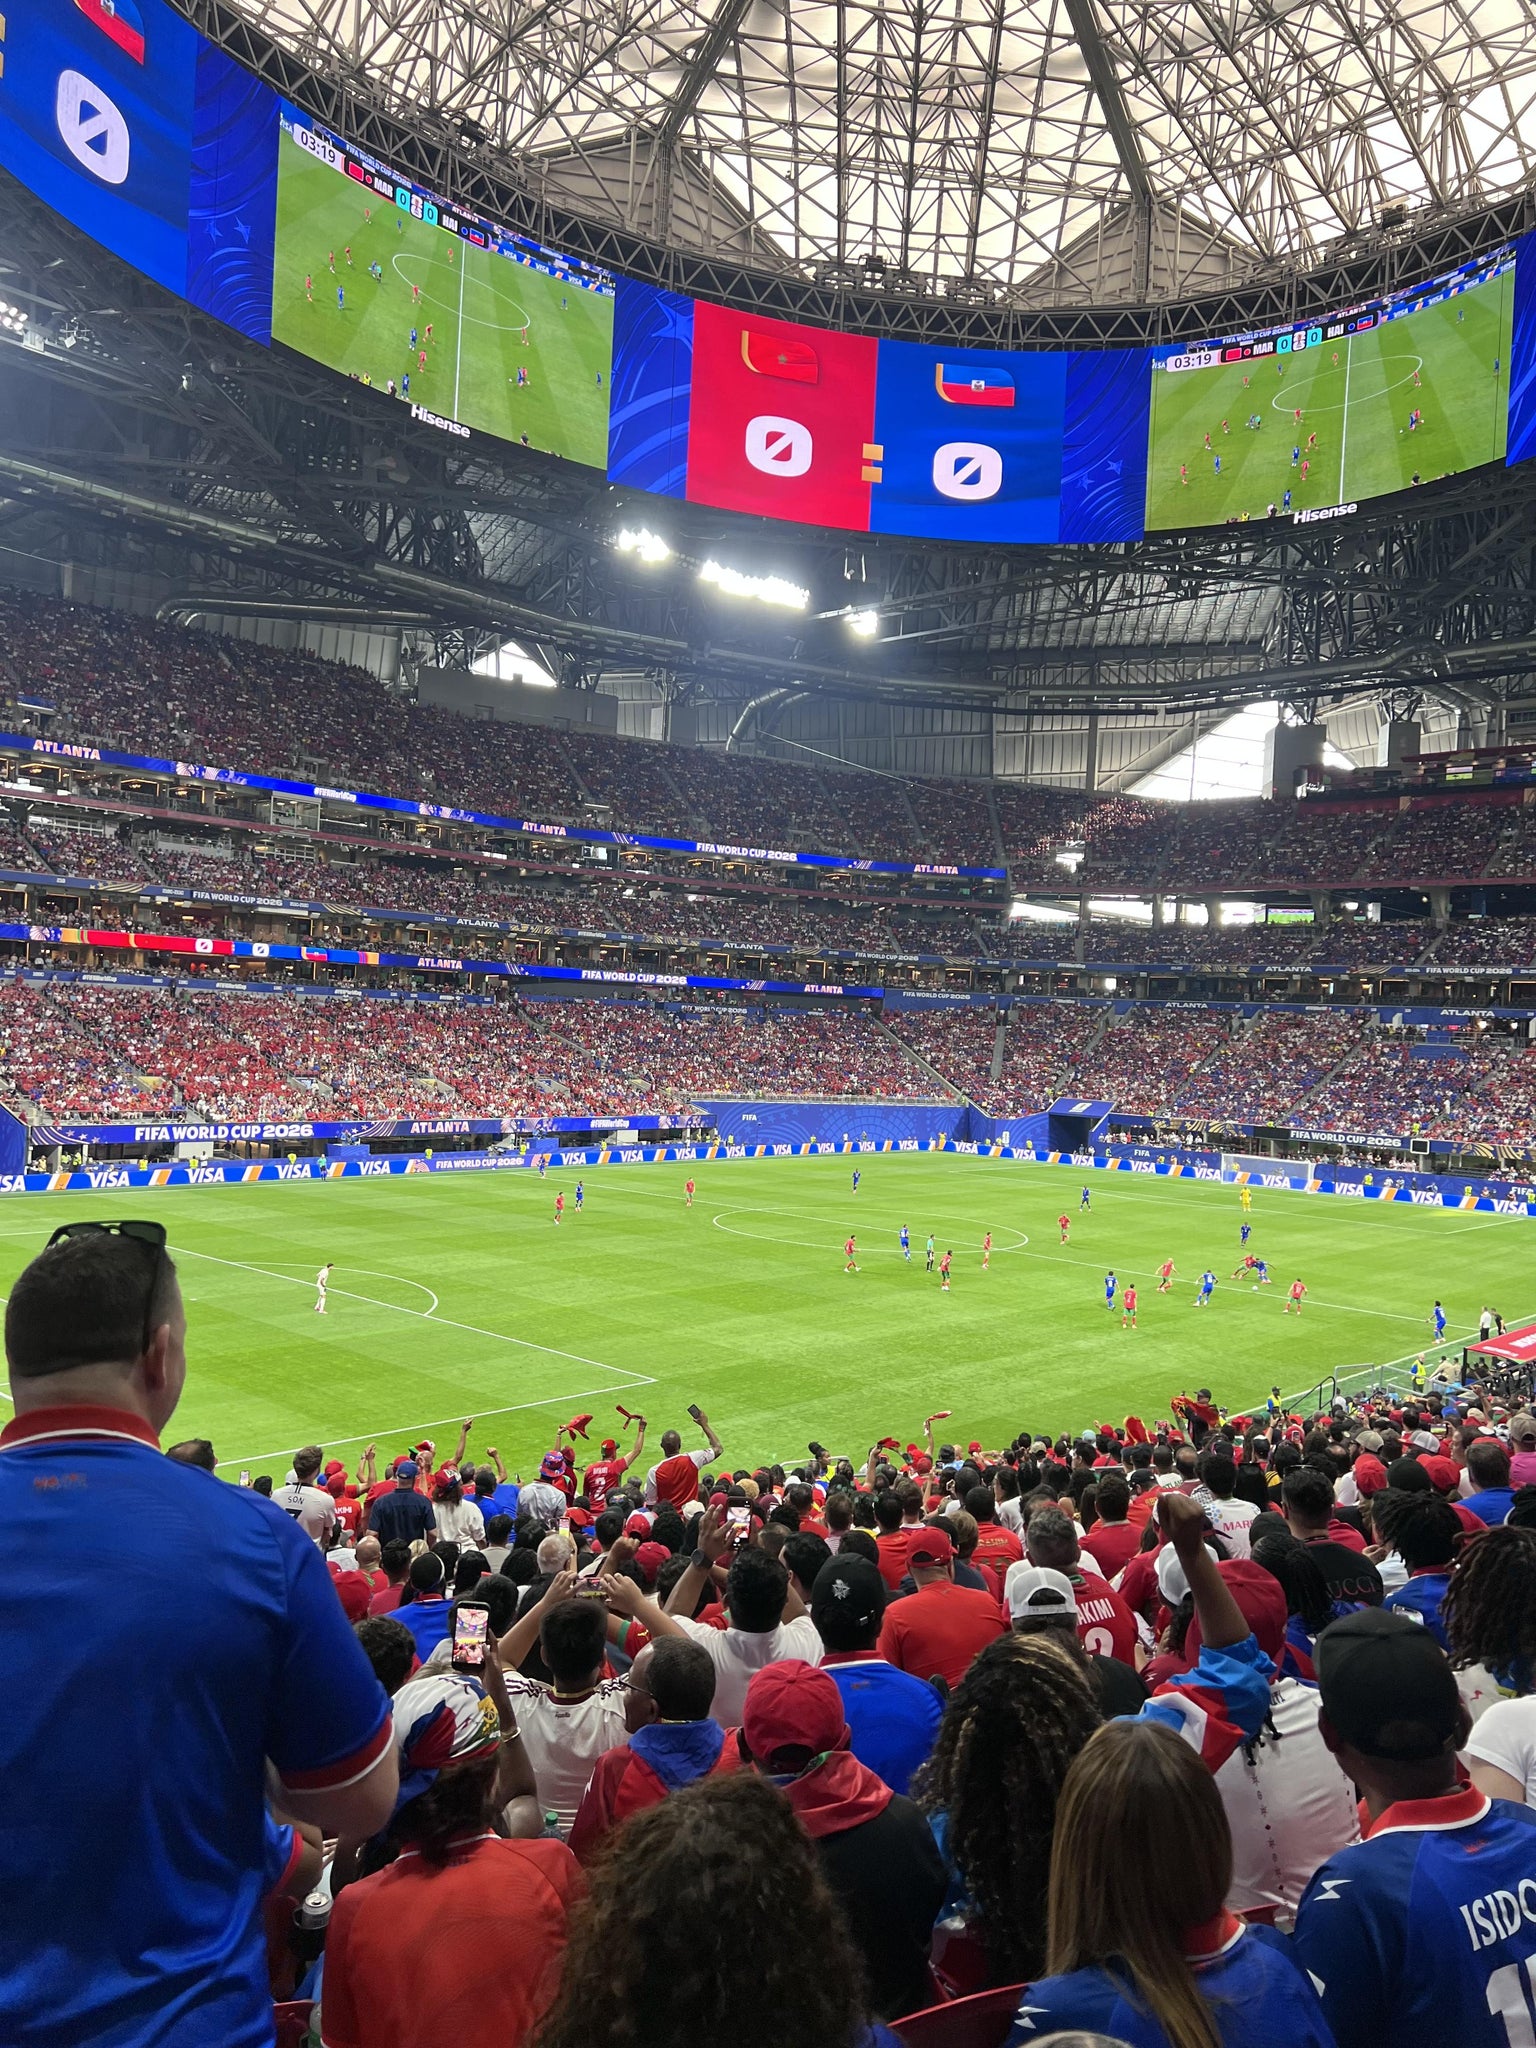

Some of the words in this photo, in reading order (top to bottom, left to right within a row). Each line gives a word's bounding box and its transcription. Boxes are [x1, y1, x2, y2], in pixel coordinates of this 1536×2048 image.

[301, 131, 336, 163] 03:19
[346, 143, 360, 157] FIFA
[359, 151, 380, 170] WORLD
[380, 164, 392, 178] CUP
[374, 177, 393, 198] MAR
[400, 194, 407, 206] 0
[427, 208, 434, 221] 0
[442, 214, 458, 232] HAI
[452, 206, 479, 224] ATLANTA
[503, 248, 517, 261] VISA
[535, 263, 549, 275] VISA
[568, 276, 582, 287] VISA
[1429, 295, 1444, 305] VISA
[1337, 306, 1366, 319] ATLANTA
[1394, 308, 1408, 319] VISA
[1222, 335, 1236, 344] FIFA
[1237, 332, 1259, 343] WORLD
[1260, 330, 1271, 339] CUP
[1174, 353, 1212, 369] 03:19
[1253, 342, 1273, 356] MAR
[1280, 337, 1287, 349] 0
[1311, 331, 1318, 343] 0
[1327, 324, 1344, 338] HAI
[410, 404, 471, 439] Hisense
[744, 415, 811, 478] 0
[933, 441, 1002, 500] 0
[1293, 502, 1357, 525] Hisense
[33, 739, 100, 760] ATLANTA
[522, 821, 566, 836] ATLANTA
[696, 842, 715, 853] FIFA
[716, 844, 748, 857] WORLD
[749, 848, 766, 859] CUP
[767, 850, 797, 861] 2026
[914, 864, 959, 875] ATLANTA
[193, 891, 210, 900] FIFA
[211, 893, 239, 903] WORLD
[240, 895, 256, 904] CUP
[256, 897, 283, 907] 2026
[456, 918, 500, 929] ATLANTA
[723, 942, 765, 951] ATLANTA
[418, 957, 462, 969] ATLANTA
[898, 954, 919, 962] 2026
[581, 970, 602, 981] FIFA
[604, 972, 636, 983] WORLD
[637, 973, 655, 983] CUP
[655, 974, 687, 985] 2026
[804, 984, 843, 994] ATLANTA
[1440, 1009, 1495, 1017] ATLANTA
[135, 1127, 170, 1141] FIFA
[173, 1125, 231, 1141] WORLD
[234, 1124, 261, 1139] CUP
[262, 1124, 313, 1138] 2026
[410, 1121, 470, 1134] ATLANTA
[898, 1140, 919, 1150] VISA
[1290, 1130, 1310, 1141] FIFA
[1311, 1132, 1345, 1143] WORLD
[1346, 1134, 1366, 1145] CUP
[1367, 1136, 1401, 1147] 2026
[675, 1147, 697, 1160] VISA
[726, 1145, 745, 1158] VISA
[772, 1143, 792, 1156] VISA
[817, 1142, 835, 1153] VISA
[859, 1141, 876, 1152] VISA
[954, 1141, 978, 1155] VISA
[1134, 1149, 1151, 1158] FIFA
[561, 1152, 587, 1166] VISA
[620, 1149, 644, 1163] VISA
[1012, 1148, 1037, 1161] VISA
[1070, 1154, 1095, 1168] VISA
[357, 1160, 391, 1176] VISA
[435, 1160, 451, 1170] FIFA
[452, 1159, 481, 1169] WORLD
[482, 1158, 496, 1168] CUP
[497, 1157, 524, 1167] 2026
[1131, 1160, 1156, 1174] VISA
[89, 1170, 130, 1188] VISA
[186, 1167, 226, 1184] VISA
[276, 1164, 312, 1180] VISA
[1194, 1166, 1221, 1181] VISA
[0, 1175, 26, 1193] SA
[1262, 1174, 1292, 1189] VISA
[1335, 1182, 1365, 1197] VISA
[1410, 1190, 1444, 1207] VISA
[1492, 1198, 1528, 1216] VISA
[287, 1496, 304, 1505] SON
[1075, 1598, 1115, 1625] AKIMI
